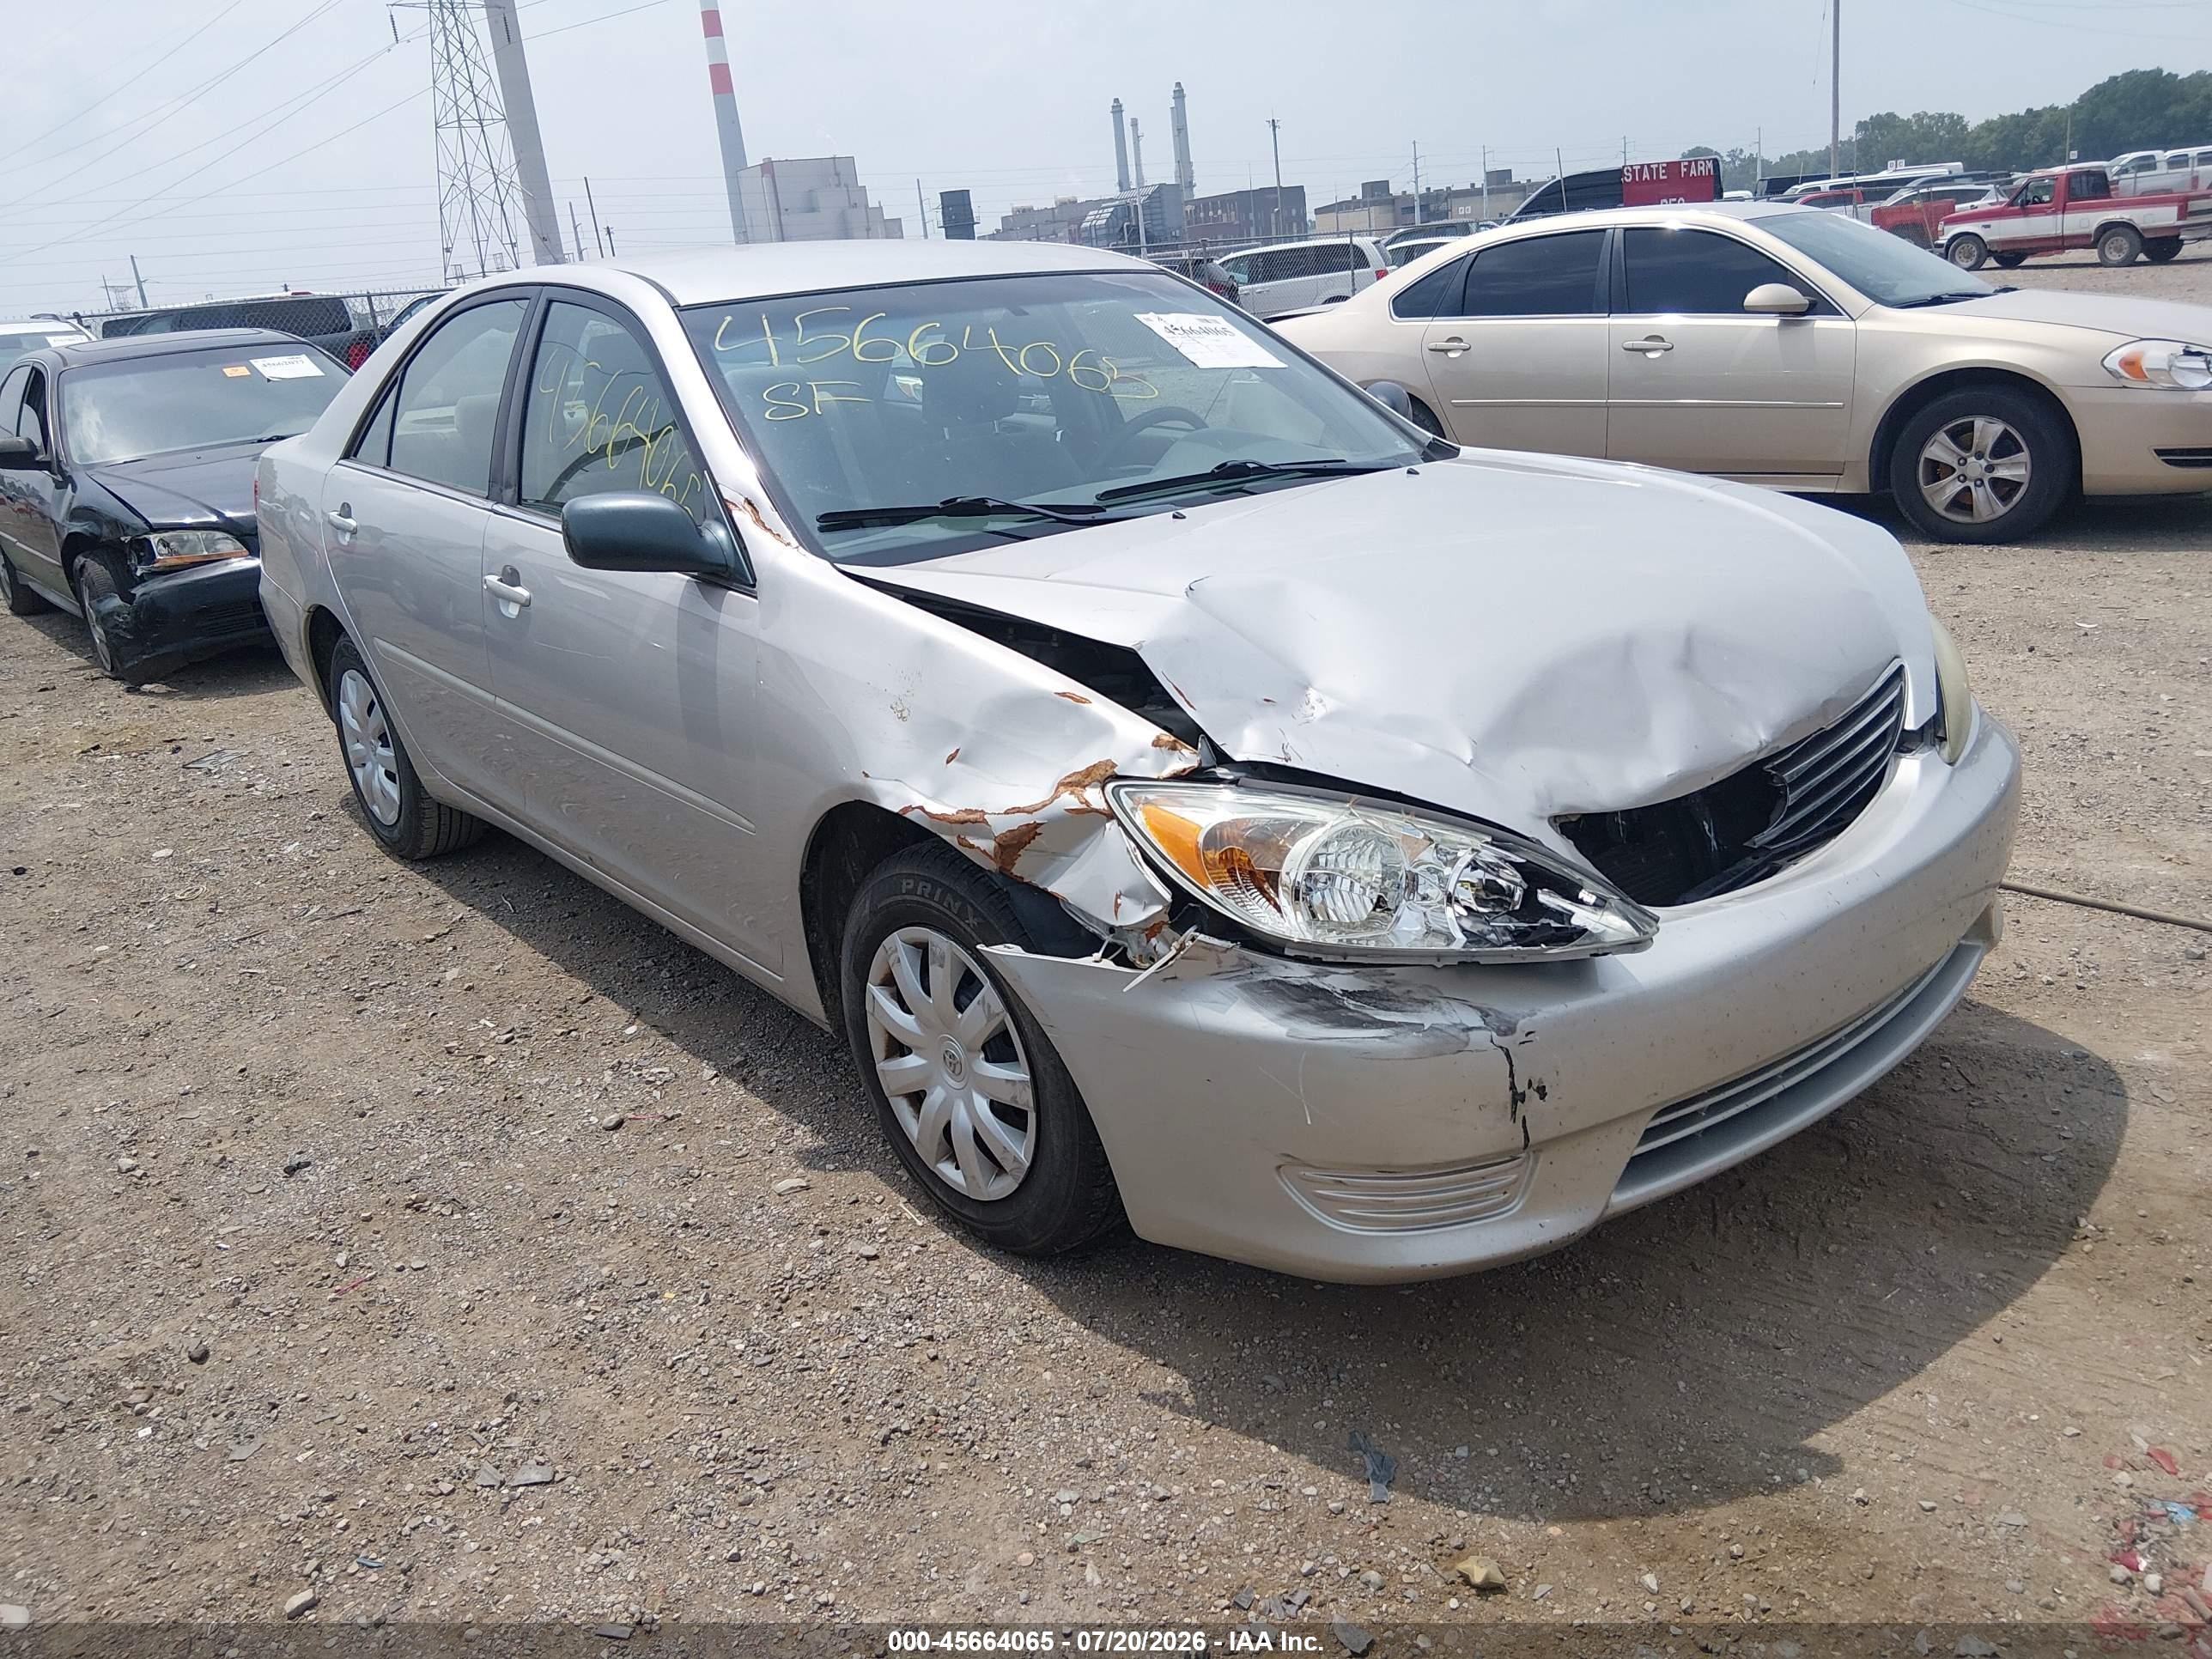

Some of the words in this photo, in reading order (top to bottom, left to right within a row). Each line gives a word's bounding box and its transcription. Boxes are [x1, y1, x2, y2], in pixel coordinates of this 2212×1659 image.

[1622, 164, 1667, 183] STATE
[1681, 160, 1713, 178] FARM
[714, 307, 1159, 399] 45664065
[764, 380, 872, 421] SF
[901, 878, 977, 928] PRINX
